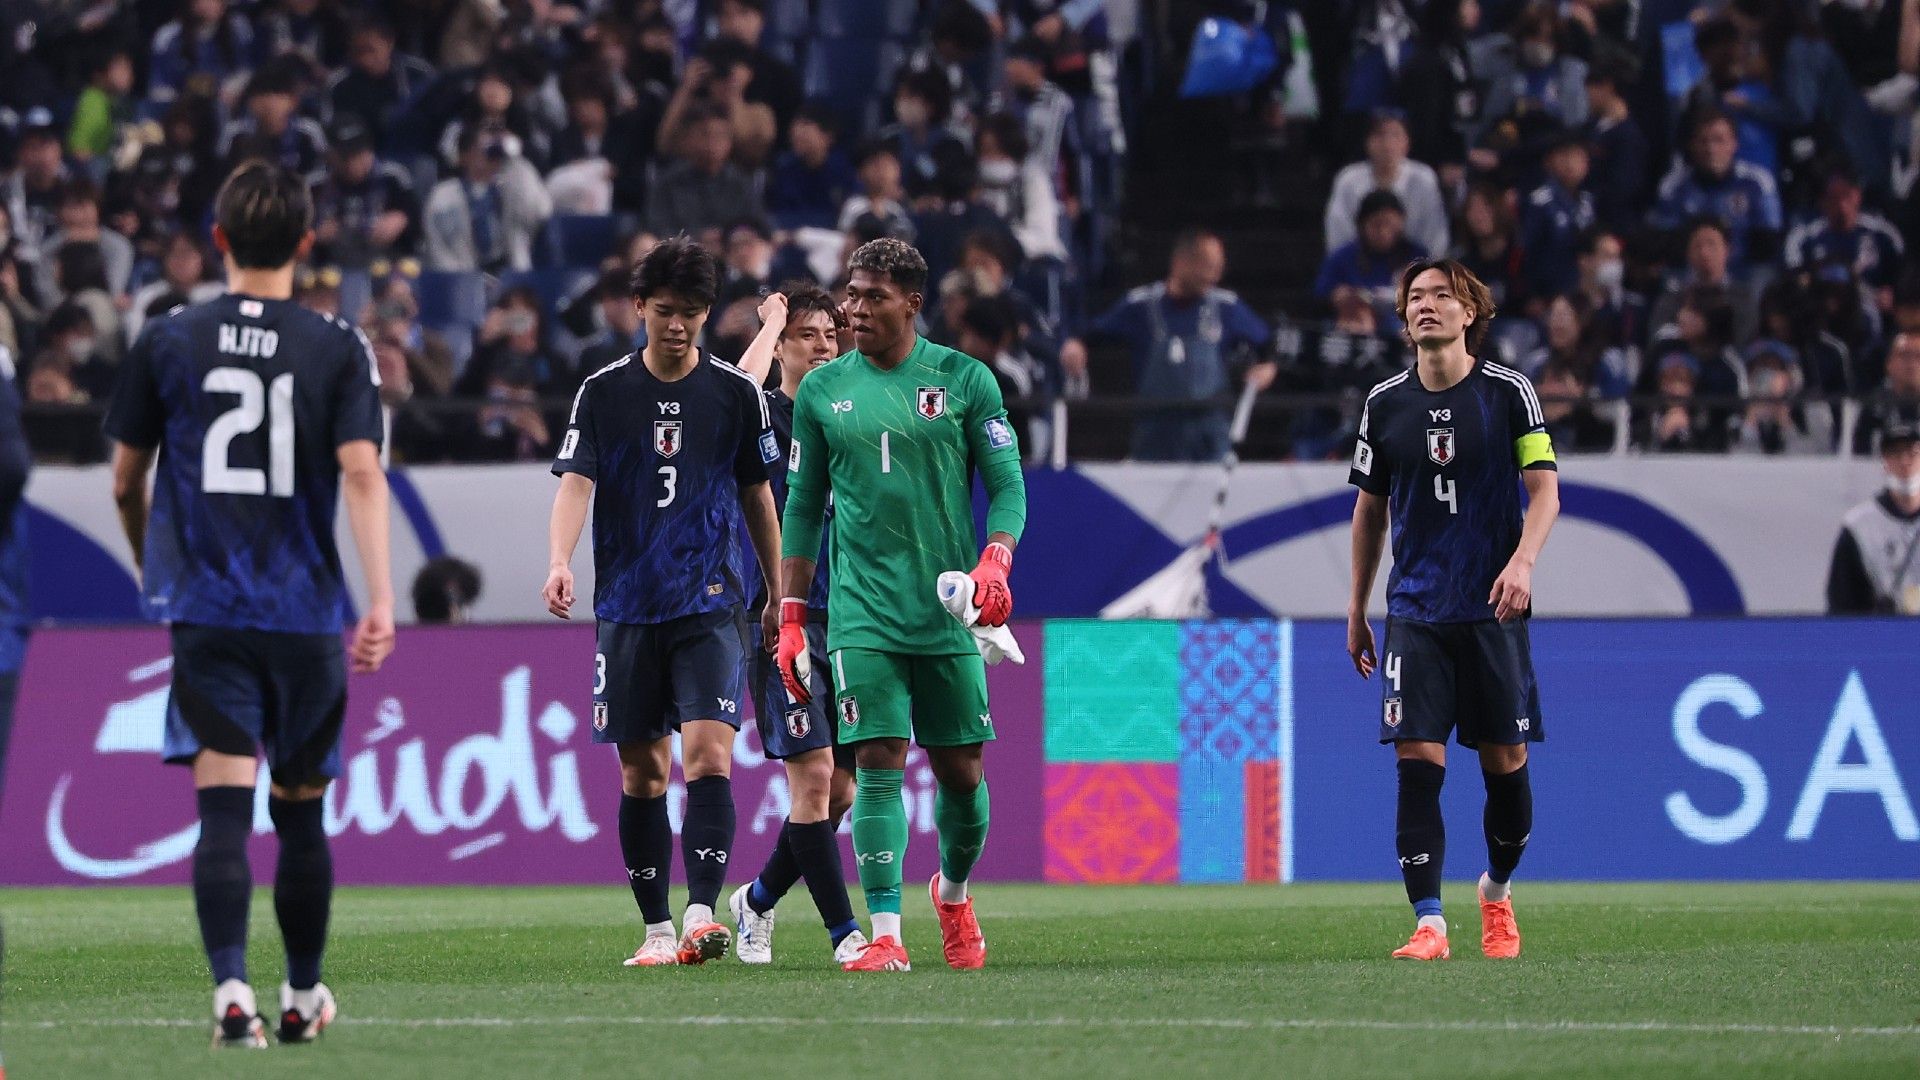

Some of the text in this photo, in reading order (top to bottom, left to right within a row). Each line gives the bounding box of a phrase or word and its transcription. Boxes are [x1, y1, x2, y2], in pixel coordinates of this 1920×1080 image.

[656, 401, 681, 415] Y-3
[830, 399, 853, 414] Y-3
[1428, 408, 1452, 423] Y-3
[203, 367, 295, 497] 21
[881, 430, 891, 474] 1
[656, 465, 678, 509] 3
[1433, 473, 1458, 514] 4
[593, 652, 607, 695] 3
[1385, 651, 1402, 691] 4
[717, 696, 737, 714] Y-3
[1516, 717, 1530, 732] Y-3
[695, 847, 728, 864] Y-3
[857, 850, 894, 866] Y-3
[1398, 853, 1430, 869] Y-3
